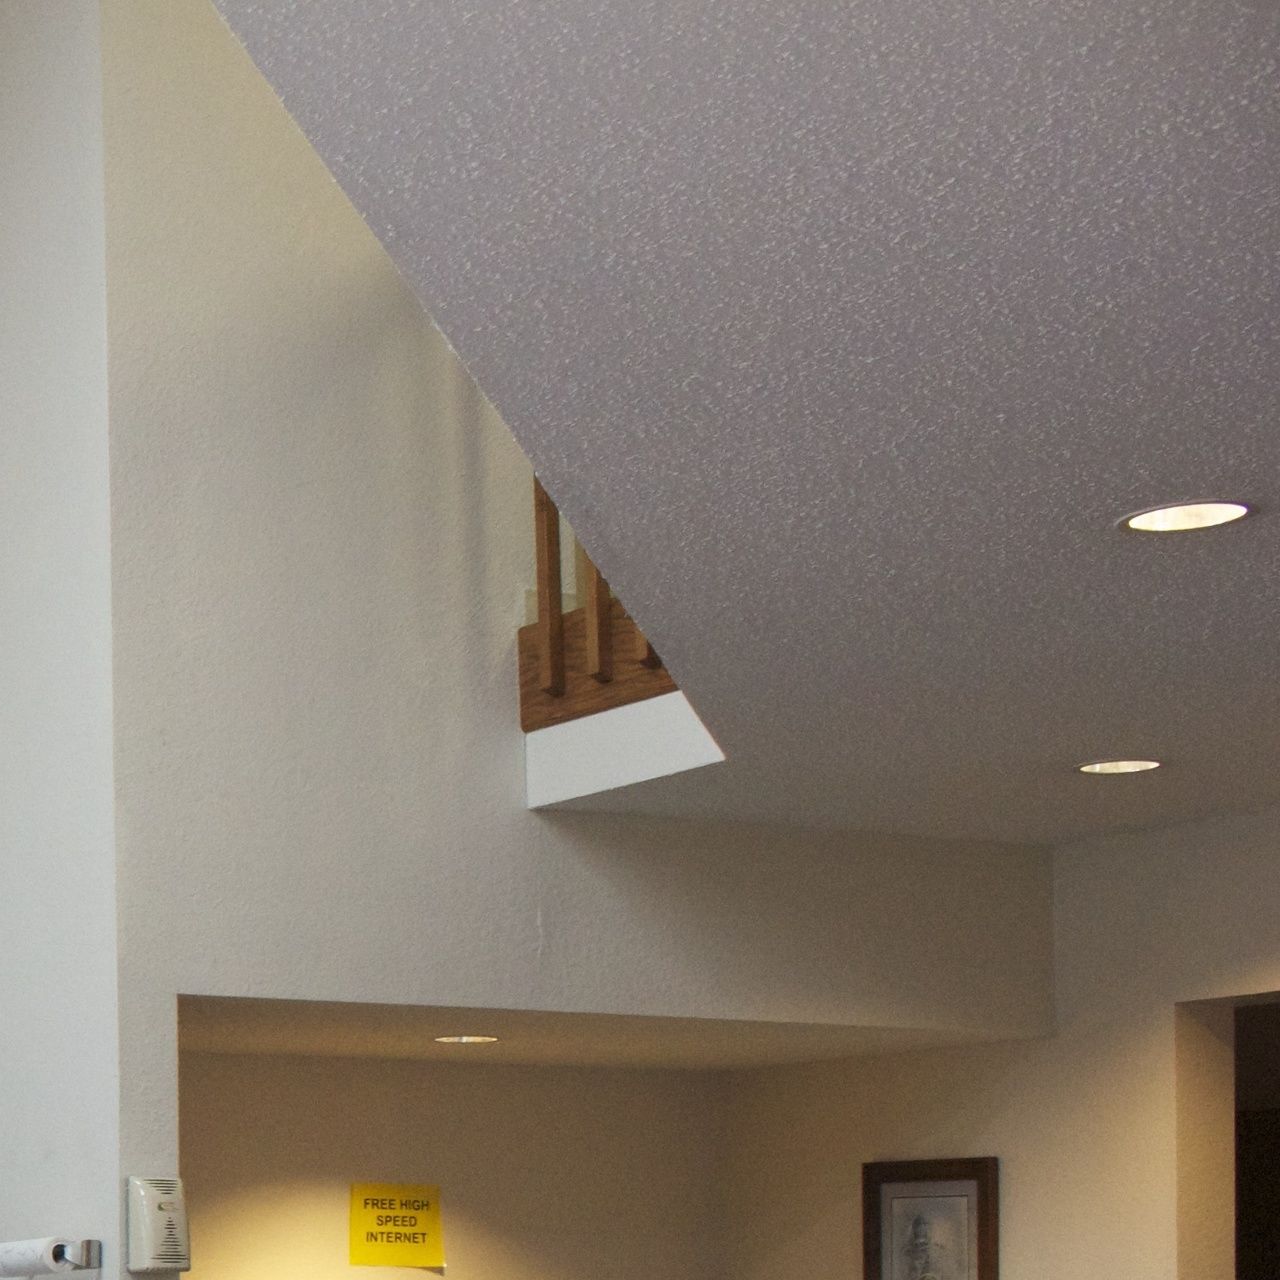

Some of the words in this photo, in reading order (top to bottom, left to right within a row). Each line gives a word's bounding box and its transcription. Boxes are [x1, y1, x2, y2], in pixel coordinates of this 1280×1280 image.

[363, 1198, 396, 1210] FREE
[400, 1199, 429, 1211] HIGH
[376, 1215, 417, 1227] SPEED
[366, 1231, 427, 1244] INTERNET
